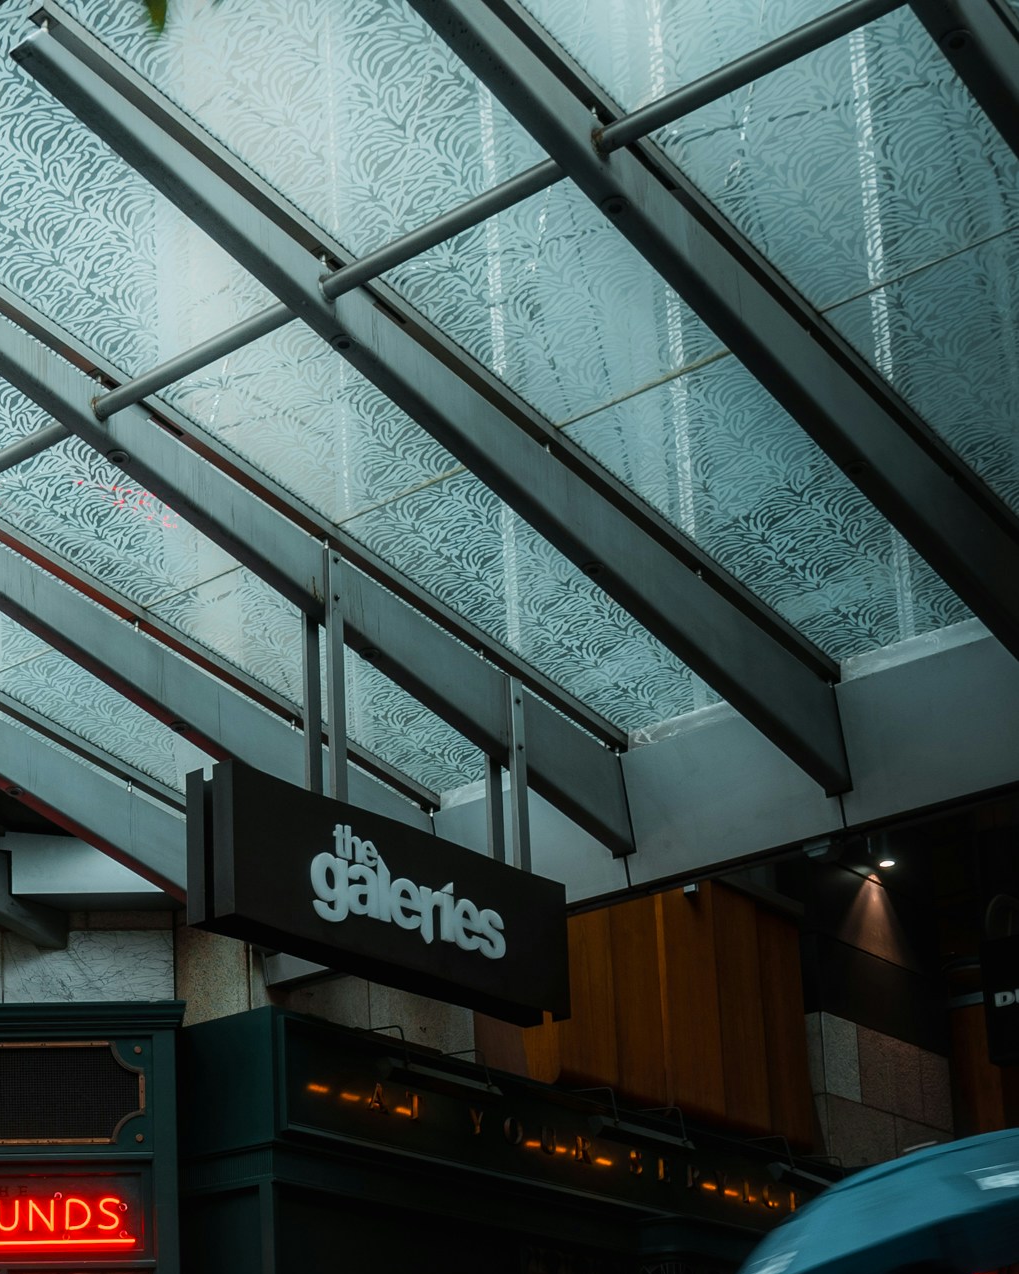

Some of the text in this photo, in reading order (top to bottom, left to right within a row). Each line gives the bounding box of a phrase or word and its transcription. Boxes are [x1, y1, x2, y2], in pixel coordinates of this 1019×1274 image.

[333, 824, 378, 868] the
[310, 852, 507, 960] galeries
[368, 1082, 422, 1122] AT
[467, 1106, 593, 1165] YOUR
